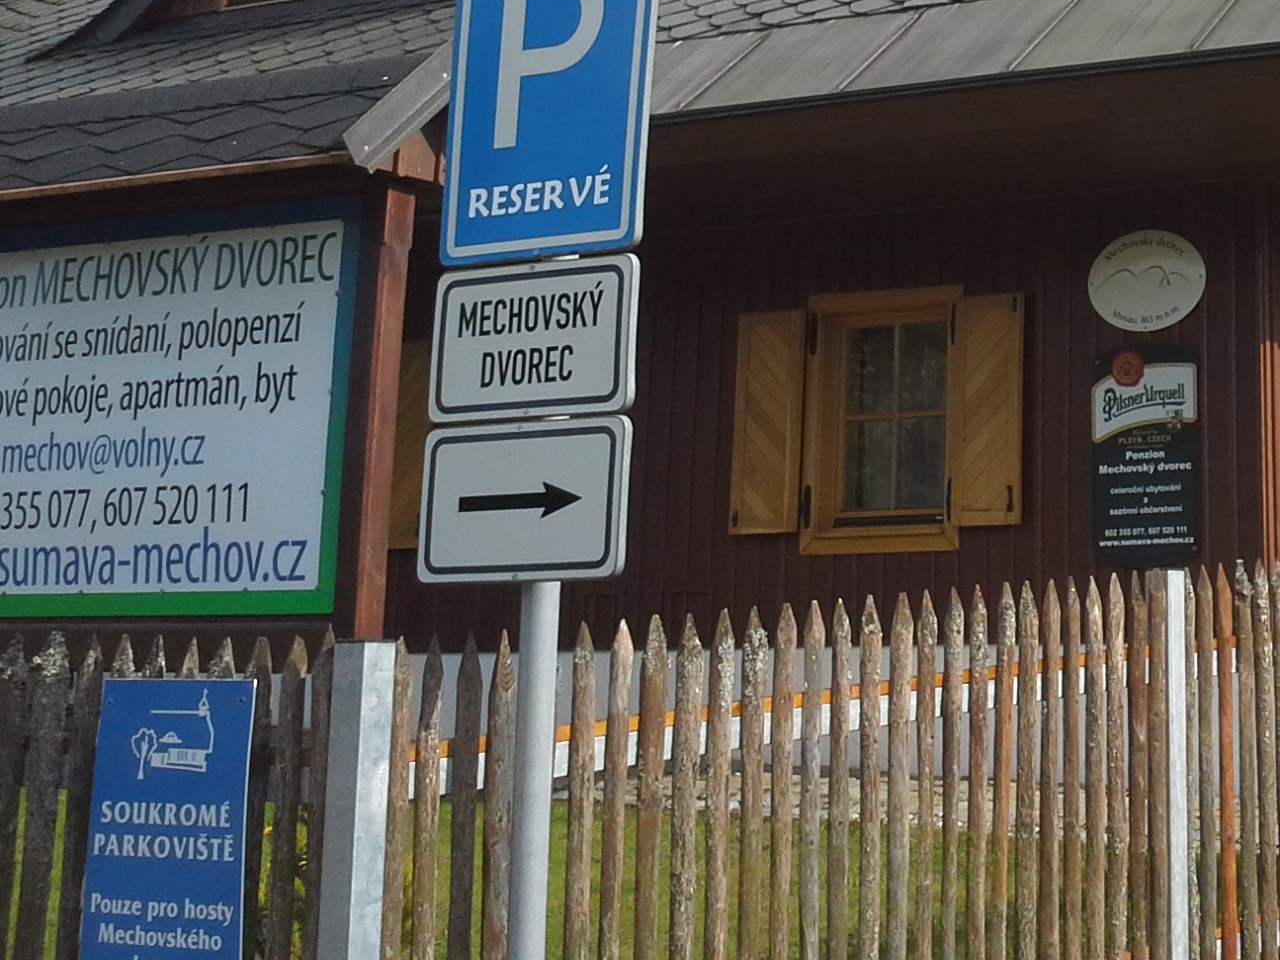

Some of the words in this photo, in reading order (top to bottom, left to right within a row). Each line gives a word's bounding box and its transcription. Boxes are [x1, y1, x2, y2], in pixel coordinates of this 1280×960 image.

[468, 165, 611, 218] RESERVÉ
[32, 235, 210, 306] MECHOVSKÝ
[214, 232, 337, 290] DVOREC
[458, 281, 604, 338] MECHOVSKÝ
[0, 321, 53, 363] vání
[52, 329, 78, 359] se
[81, 311, 172, 358] snídaní,
[178, 301, 305, 360] polopenzí
[480, 345, 574, 388] DVOREC
[0, 378, 30, 417] vé
[32, 374, 113, 426] pokoje,
[120, 365, 247, 420] apartmán,
[254, 361, 297, 414] byt
[1103, 387, 1145, 422] Pilsner
[1143, 383, 1185, 408] Urquell
[1, 427, 206, 477] mechov@volny.cz
[1099, 463, 1155, 474] Mechovský
[1157, 462, 1192, 471] dvorec
[1125, 450, 1165, 460] Penzion
[1, 491, 41, 530] 355
[48, 489, 97, 534] 077,
[103, 486, 147, 527] 607
[152, 484, 198, 525] 520
[206, 482, 250, 523] 111
[1176, 526, 1187, 534] 111
[0, 526, 307, 587] sumava-mechov.cz
[101, 800, 231, 828] SOUKROMÉ
[93, 833, 235, 862] PARKOVIŠTĚ
[90, 892, 142, 916] Pouze
[147, 899, 178, 922] pro
[184, 898, 234, 927] hosty
[98, 922, 222, 951] Mechovského
